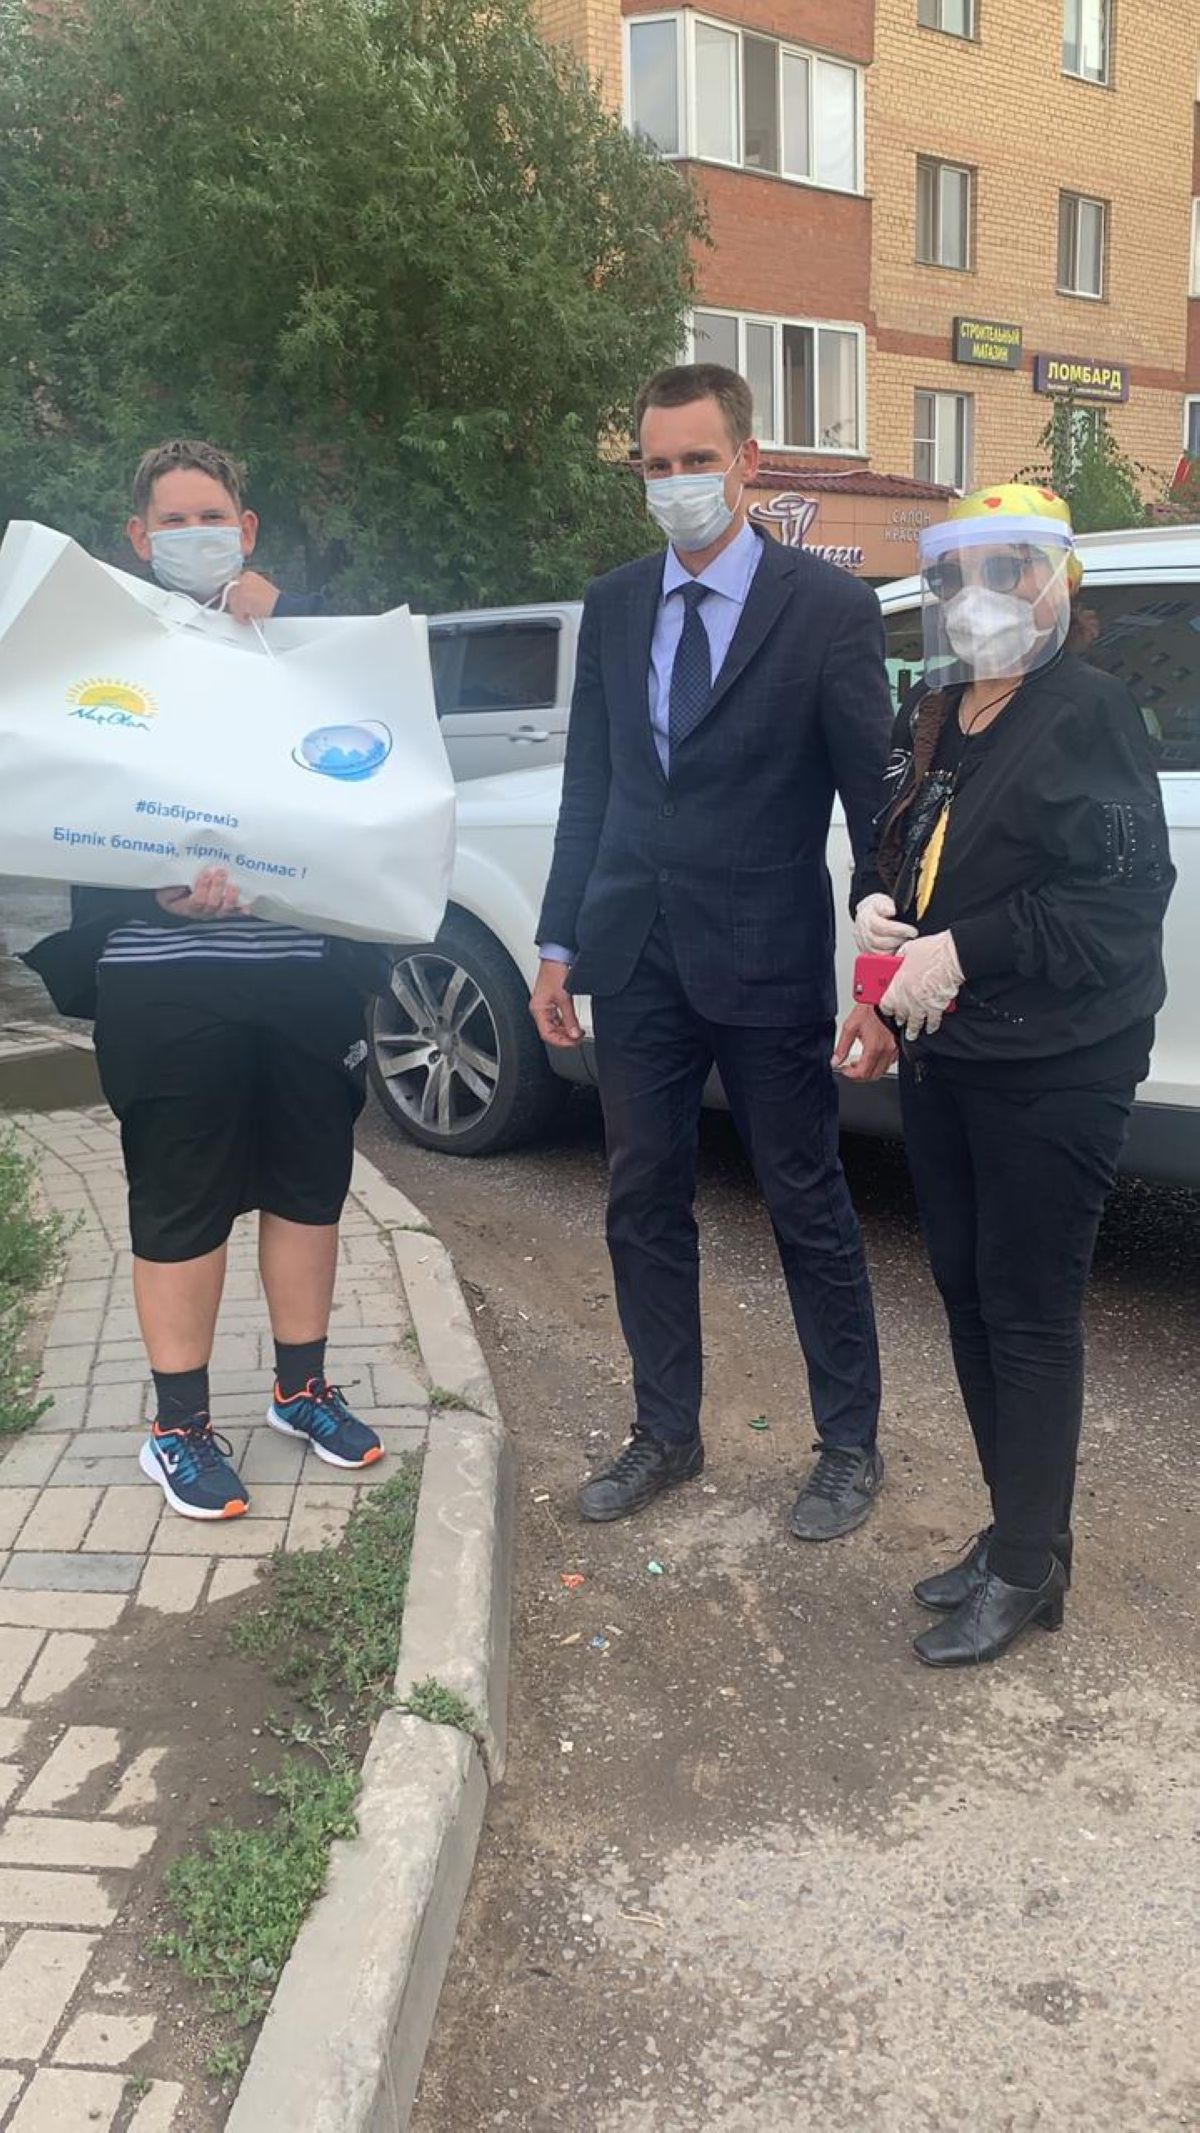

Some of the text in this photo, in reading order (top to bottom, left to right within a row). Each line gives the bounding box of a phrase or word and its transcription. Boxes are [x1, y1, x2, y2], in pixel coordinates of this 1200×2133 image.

[960, 321, 1021, 346] СТРОИТЕЛЬНЫЙ
[971, 341, 1009, 362] МАГАЗИН
[1047, 361, 1122, 391] ЛОМБАРД
[890, 510, 931, 526] САЛОН
[135, 799, 240, 828] #бізбіргеміз
[53, 826, 107, 846] Бірлік
[111, 834, 180, 858] болмай,
[185, 843, 231, 862] тірлік
[235, 853, 298, 878] болмас
